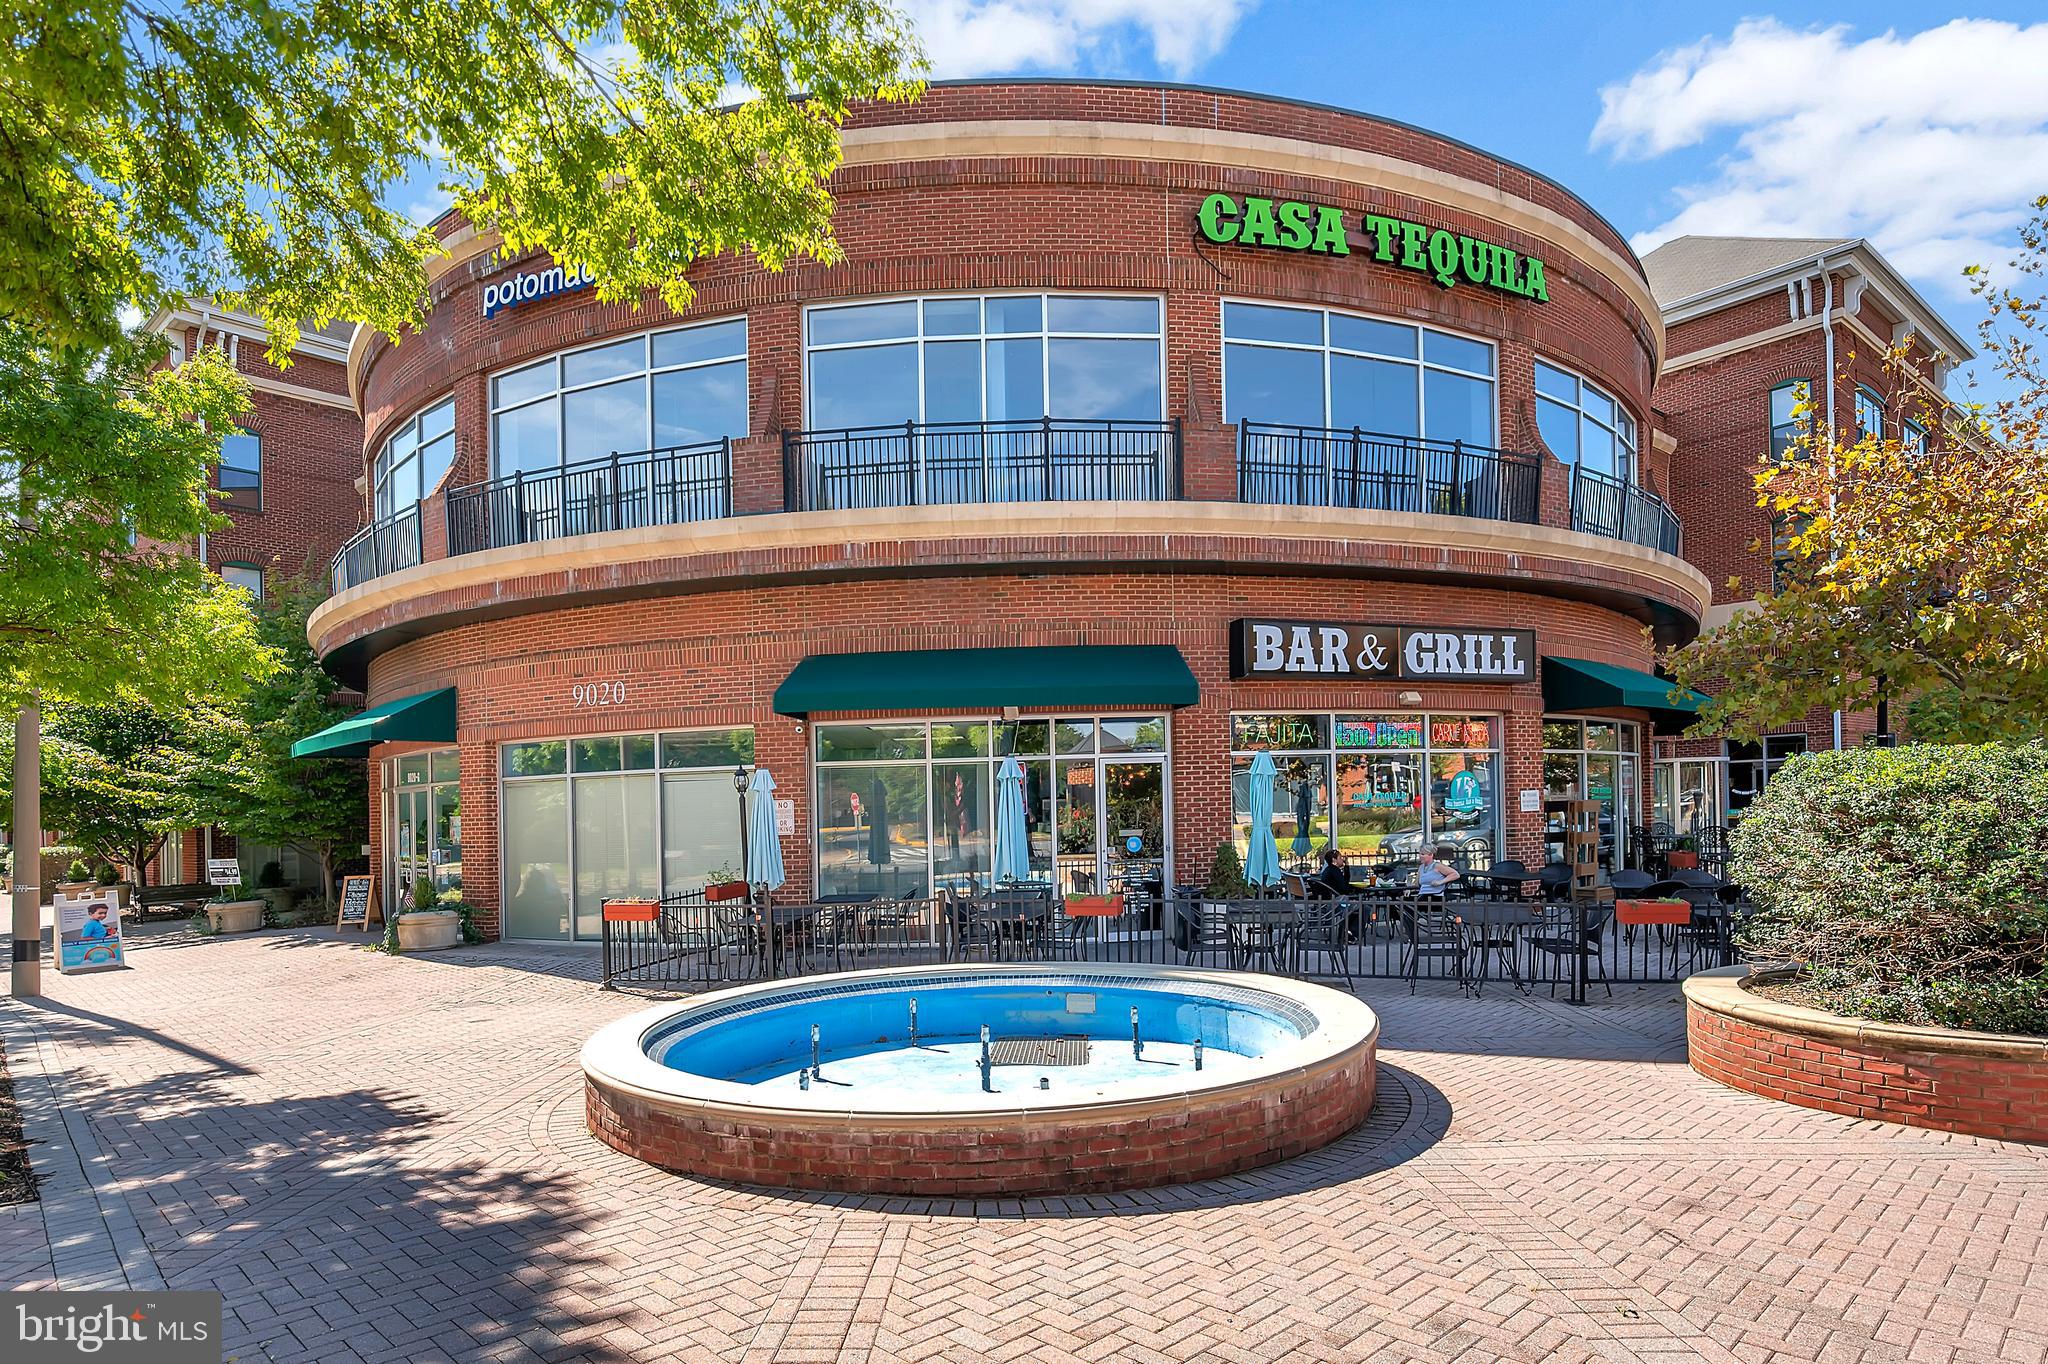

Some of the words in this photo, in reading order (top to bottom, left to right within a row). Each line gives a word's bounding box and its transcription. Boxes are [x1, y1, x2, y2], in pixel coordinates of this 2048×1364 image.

[1198, 193, 1350, 255] CASA
[1366, 214, 1550, 302] TEQUILA
[1252, 624, 1350, 673] BAR
[1356, 633, 1388, 671] &
[1404, 632, 1525, 675] GRILL
[572, 681, 626, 708] 9020
[778, 801, 789, 809] NO
